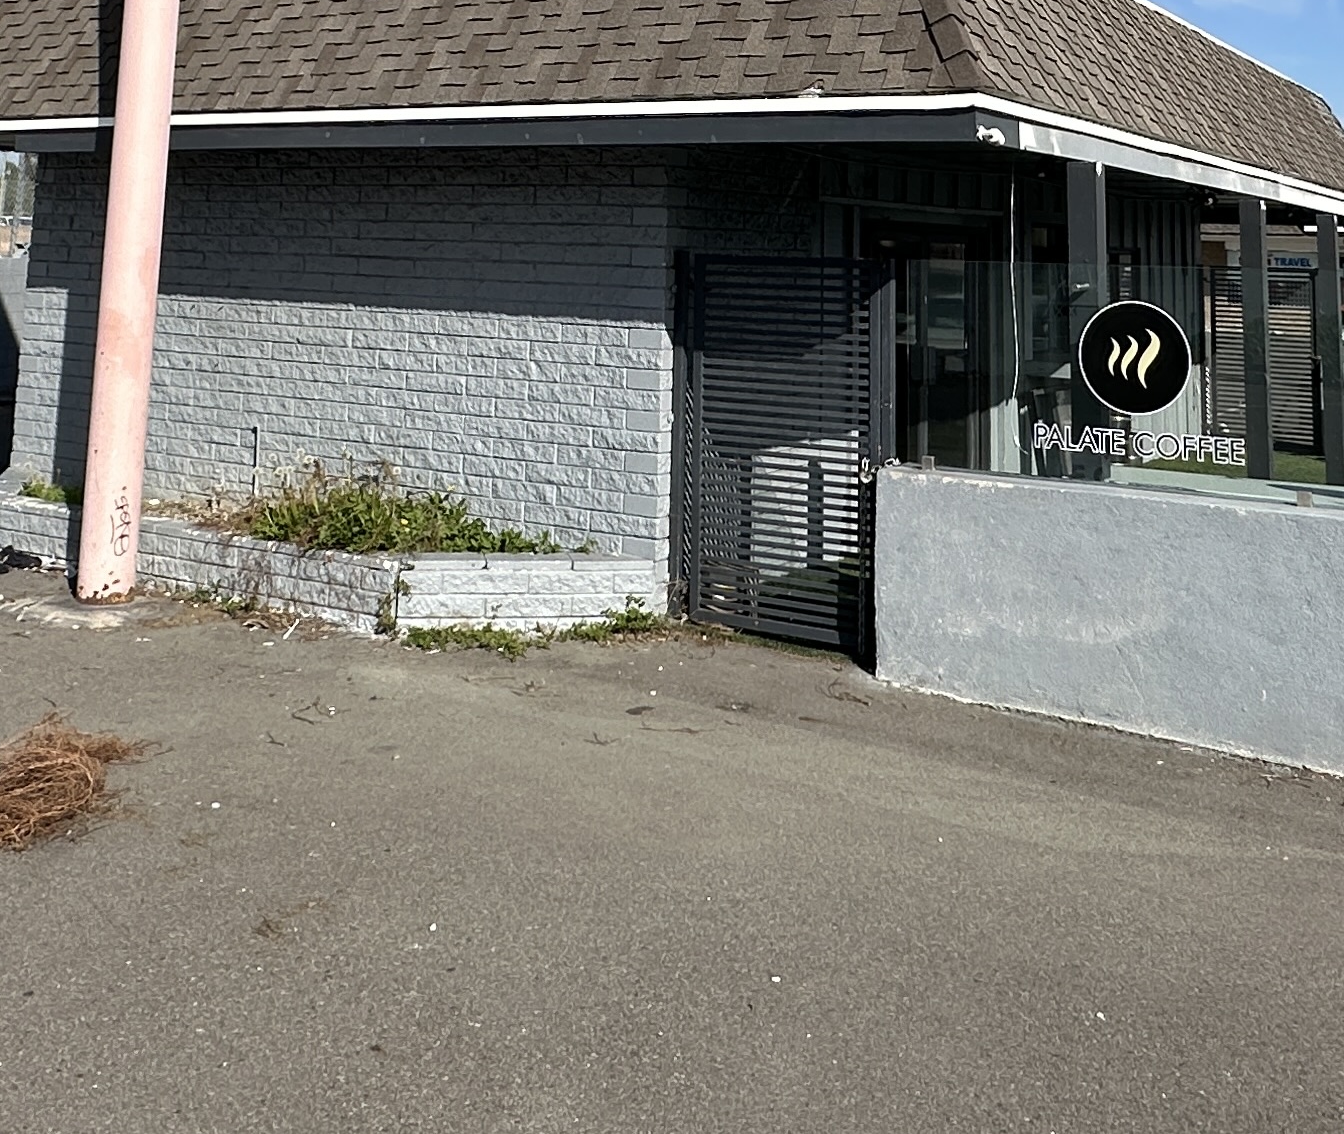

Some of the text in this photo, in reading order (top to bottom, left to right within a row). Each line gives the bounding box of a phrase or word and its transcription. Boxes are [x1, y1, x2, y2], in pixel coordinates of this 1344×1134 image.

[1274, 257, 1312, 268] TRAVEL
[1033, 422, 1246, 466] PALATE COFFEE
